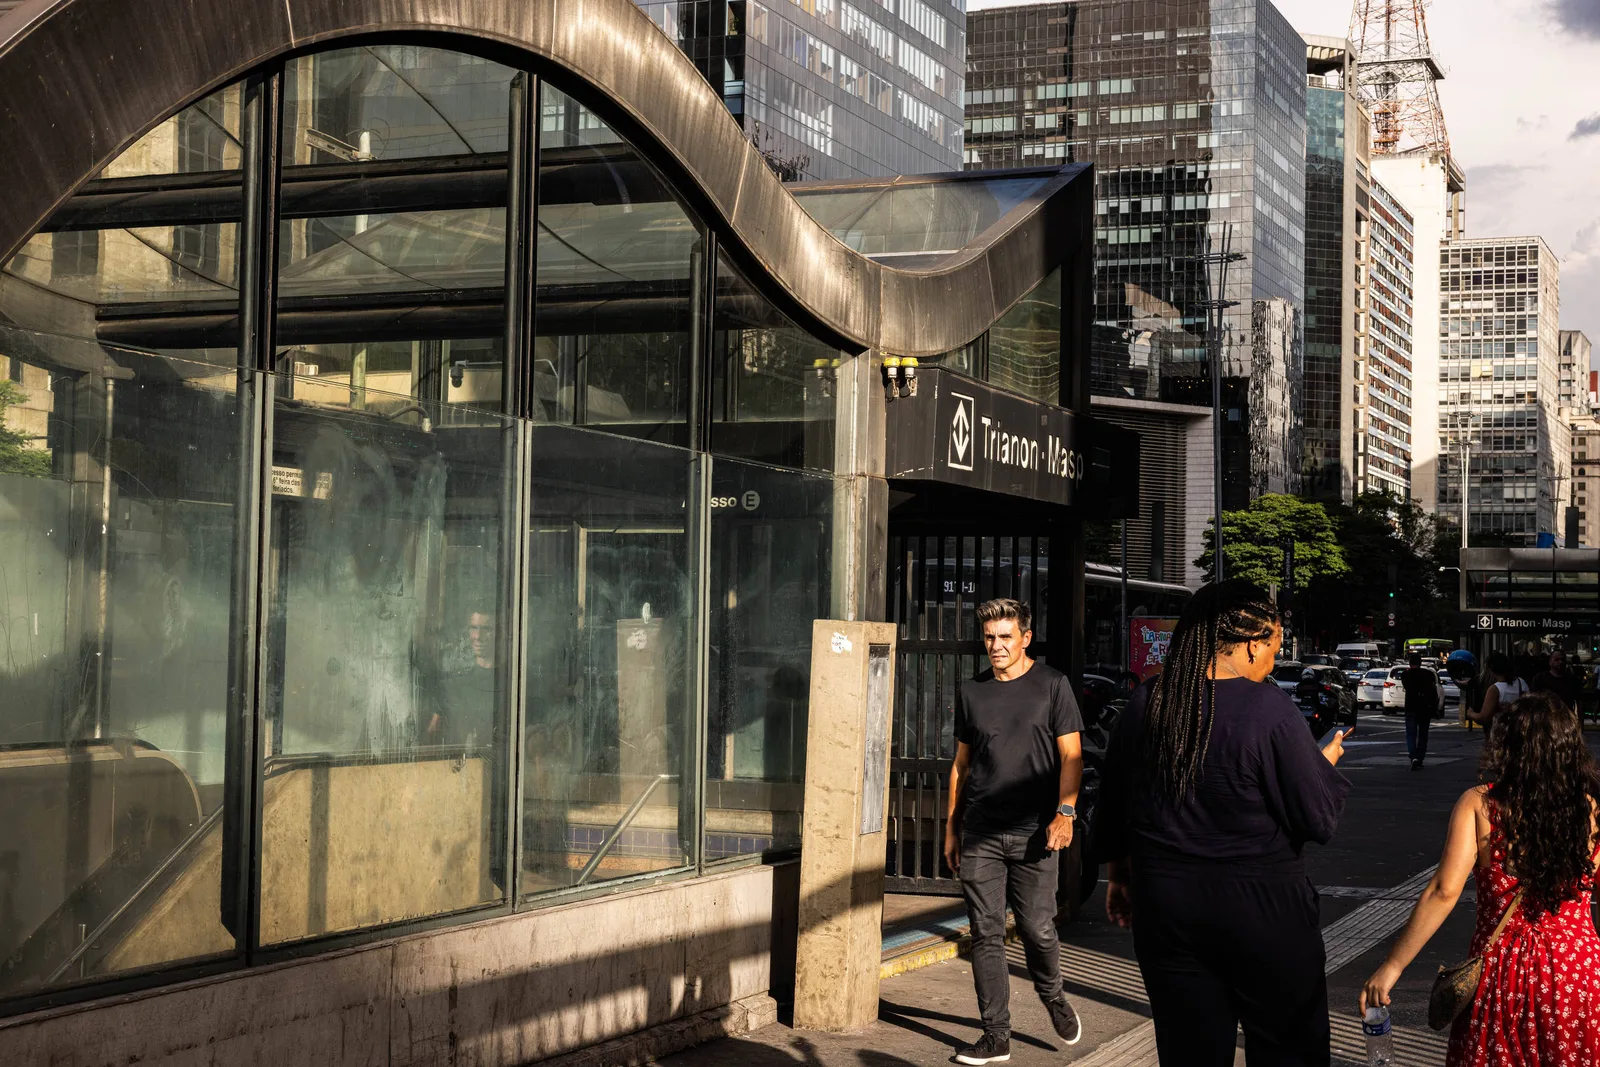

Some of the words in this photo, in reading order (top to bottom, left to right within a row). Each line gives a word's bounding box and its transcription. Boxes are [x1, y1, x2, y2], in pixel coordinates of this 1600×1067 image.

[981, 416, 1038, 471] Trianon
[1047, 434, 1084, 491] Masp
[1497, 617, 1536, 628] Trianon
[1542, 618, 1572, 630] Masp
